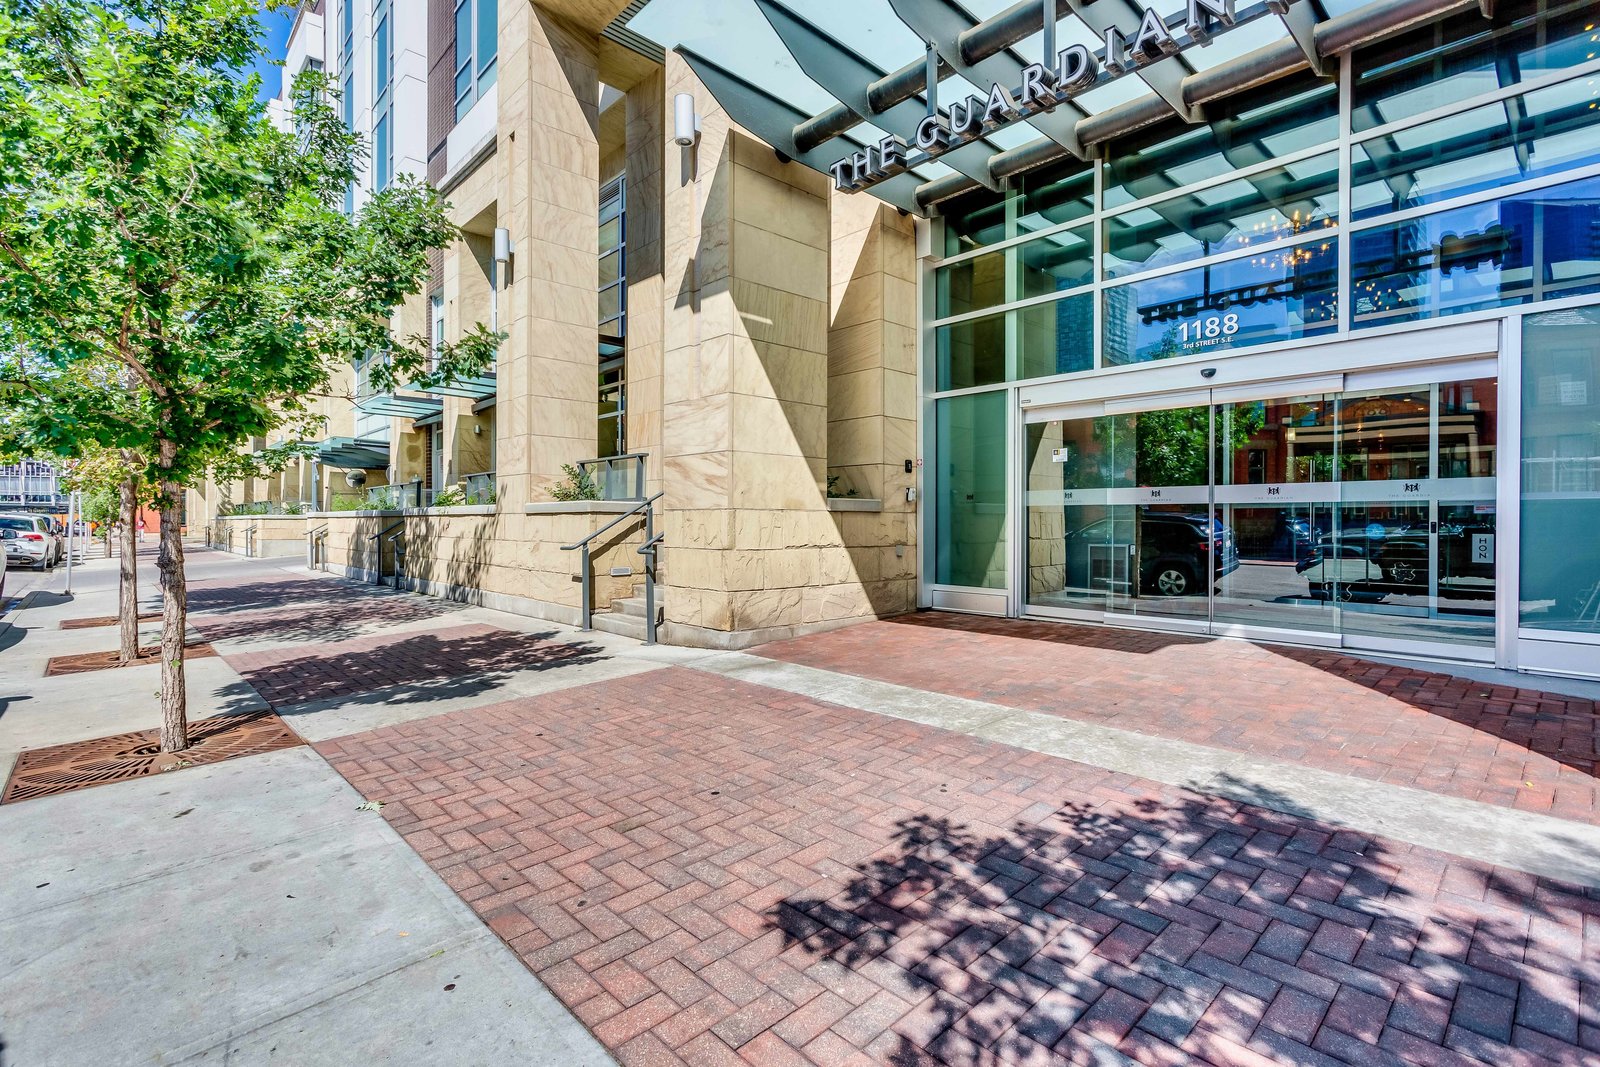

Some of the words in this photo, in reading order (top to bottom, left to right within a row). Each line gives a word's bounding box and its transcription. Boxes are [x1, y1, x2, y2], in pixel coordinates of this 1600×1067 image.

[829, 134, 902, 190] THE
[916, 0, 1230, 150] GUARDIAN
[1178, 313, 1239, 342] 1188
[1182, 342, 1194, 350] 3rd
[1195, 338, 1219, 347] STREET
